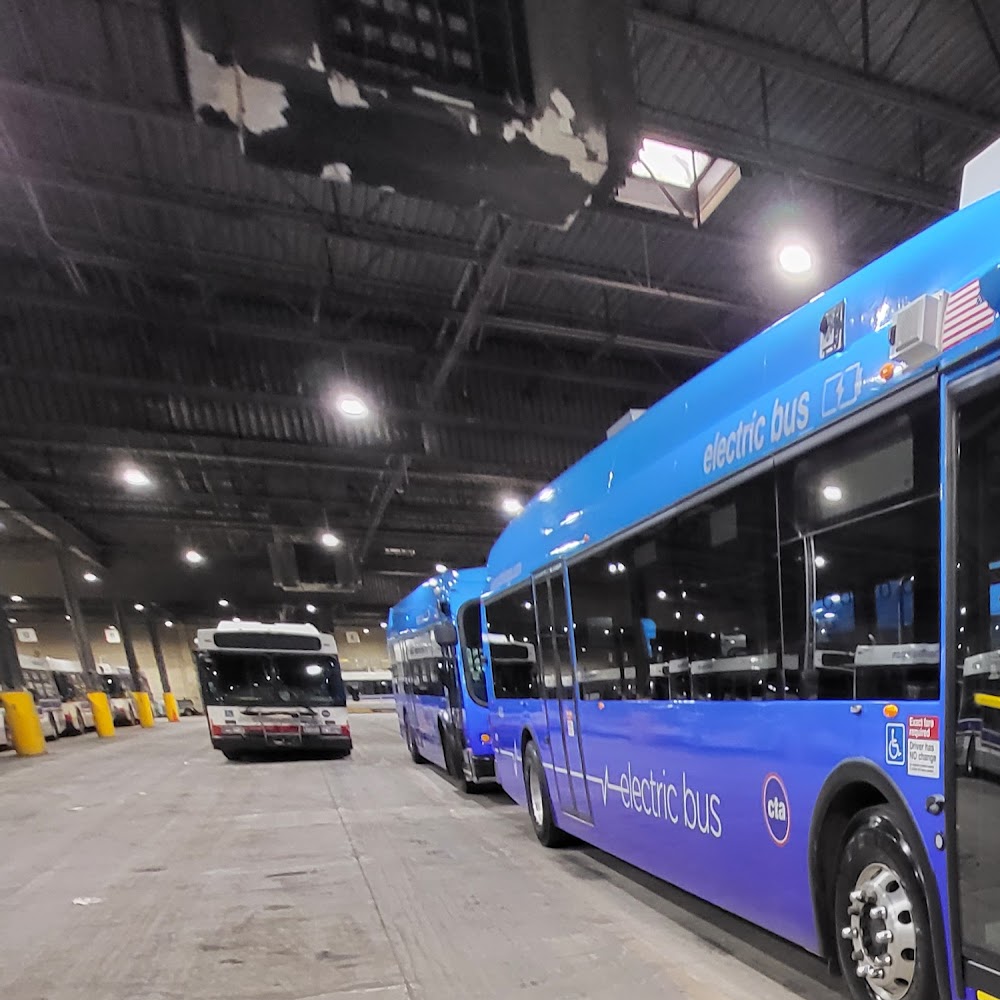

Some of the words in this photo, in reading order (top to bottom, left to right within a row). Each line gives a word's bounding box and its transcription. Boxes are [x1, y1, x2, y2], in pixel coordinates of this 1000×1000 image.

[703, 409, 766, 474] electric
[770, 391, 810, 443] bus
[909, 741, 924, 751] Driver
[925, 743, 935, 752] has
[909, 751, 917, 761] NO
[918, 753, 937, 764] change
[620, 761, 679, 824] electric
[683, 771, 722, 838] bus
[767, 797, 786, 821] cta
